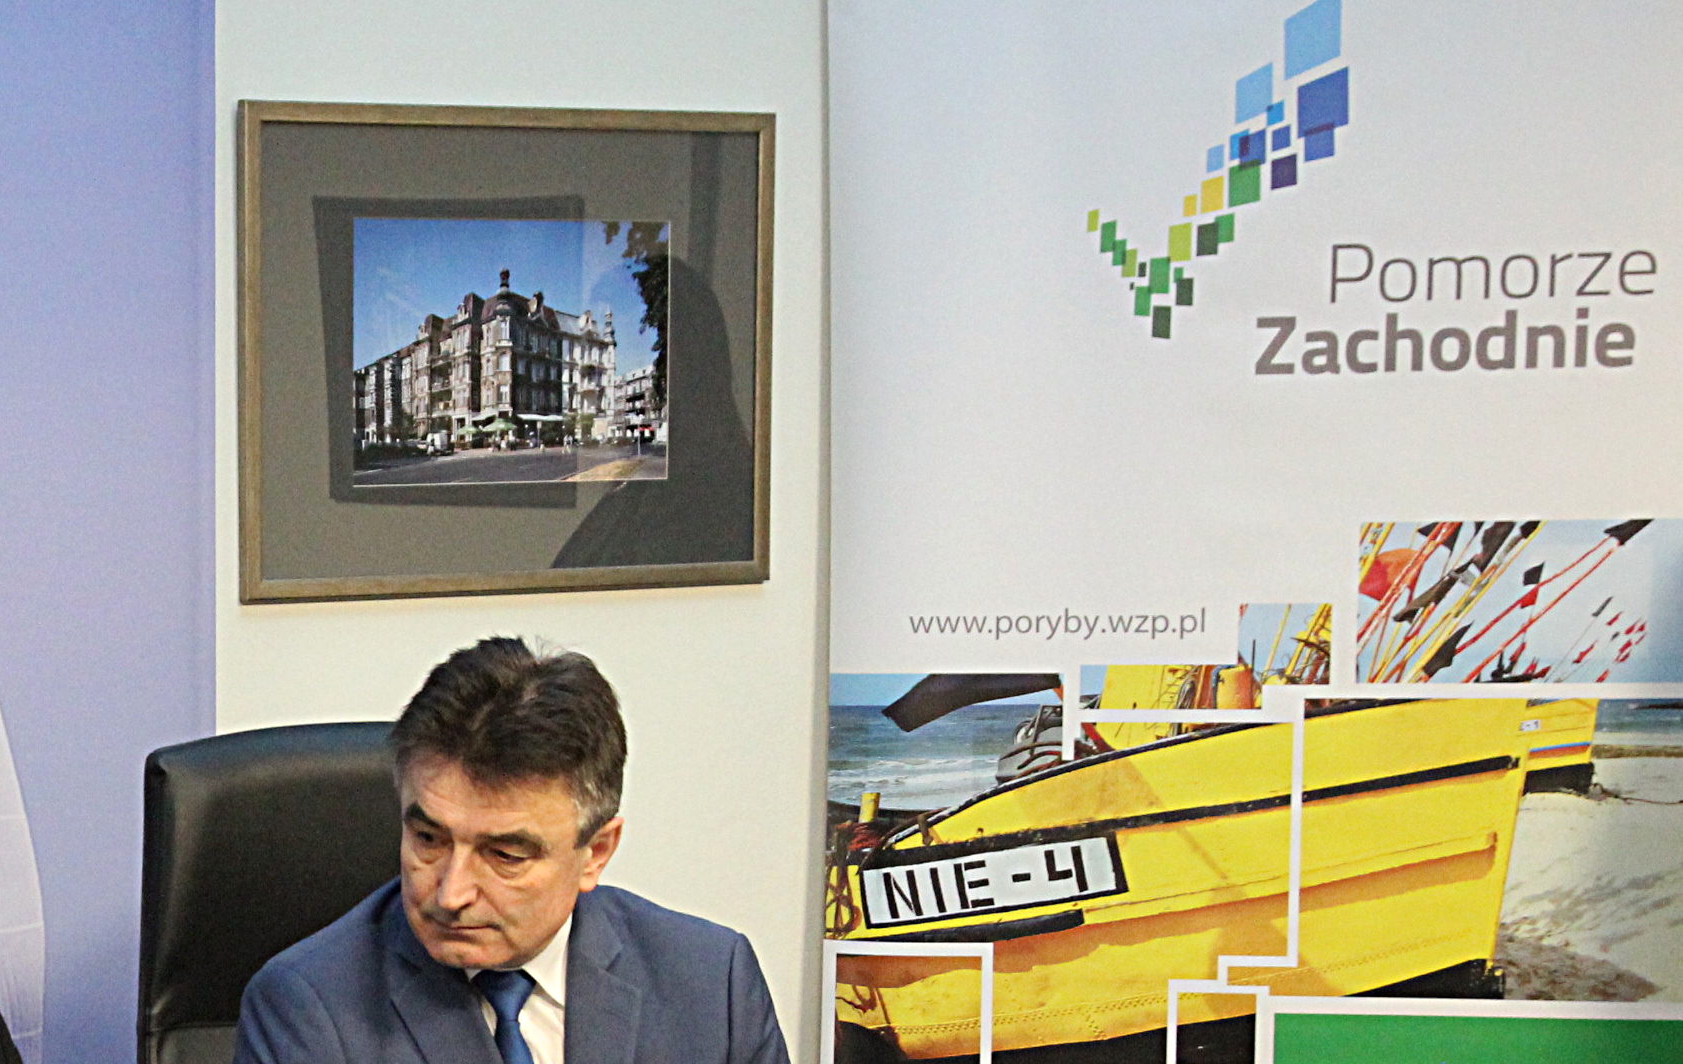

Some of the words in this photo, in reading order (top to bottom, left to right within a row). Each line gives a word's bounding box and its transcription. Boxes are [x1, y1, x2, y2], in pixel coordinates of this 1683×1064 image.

[1330, 243, 1658, 304] Pomorze
[1254, 306, 1637, 375] Zachodnie
[909, 607, 1207, 640] www.poryby.wzp.pl
[882, 845, 1089, 920] NIE-4
